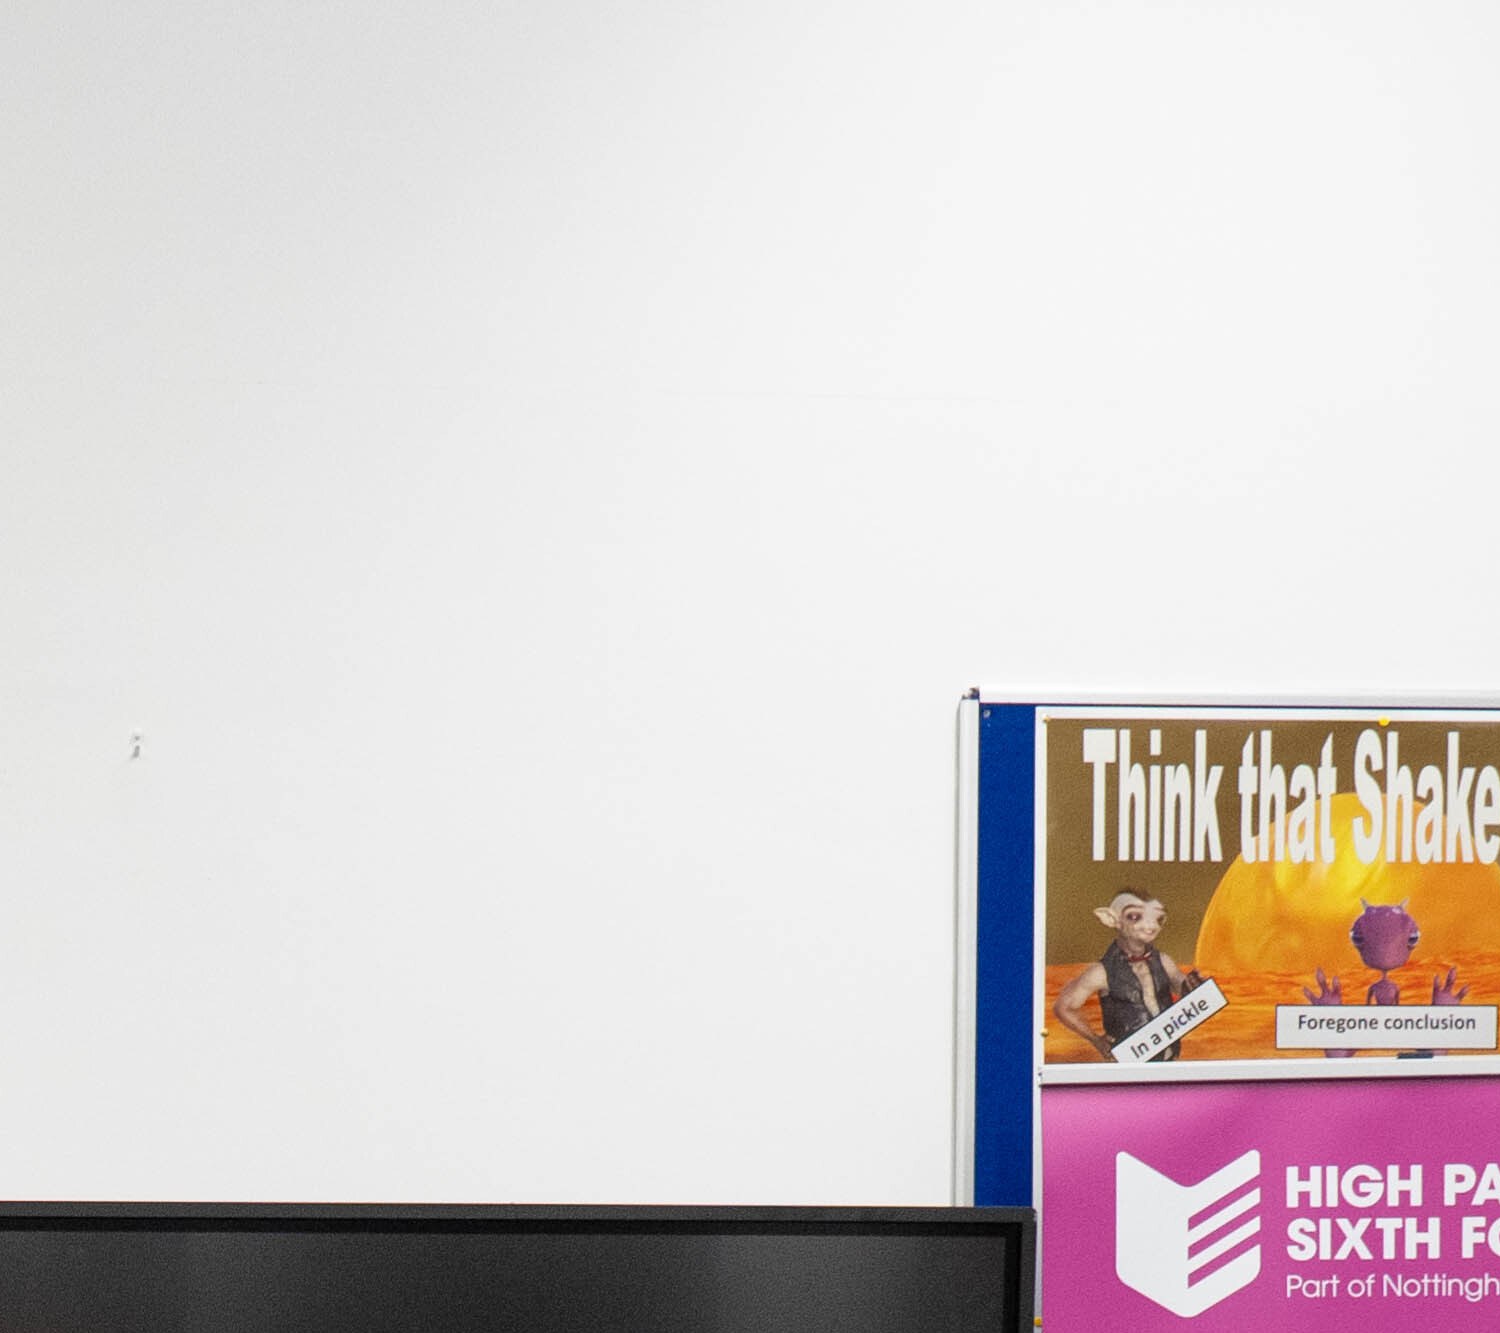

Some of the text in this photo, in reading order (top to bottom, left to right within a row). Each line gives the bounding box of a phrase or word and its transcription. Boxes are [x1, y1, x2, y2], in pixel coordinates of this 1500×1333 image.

[1083, 728, 1224, 864] Think
[1239, 729, 1336, 864] that
[1129, 999, 1210, 1059] In a pickle
[1297, 1011, 1477, 1036] Foregone conclusion
[1286, 1163, 1424, 1207] HIGH
[1286, 1216, 1441, 1261] SIXTH
[1286, 1274, 1342, 1299] Part
[1347, 1272, 1375, 1298] of
